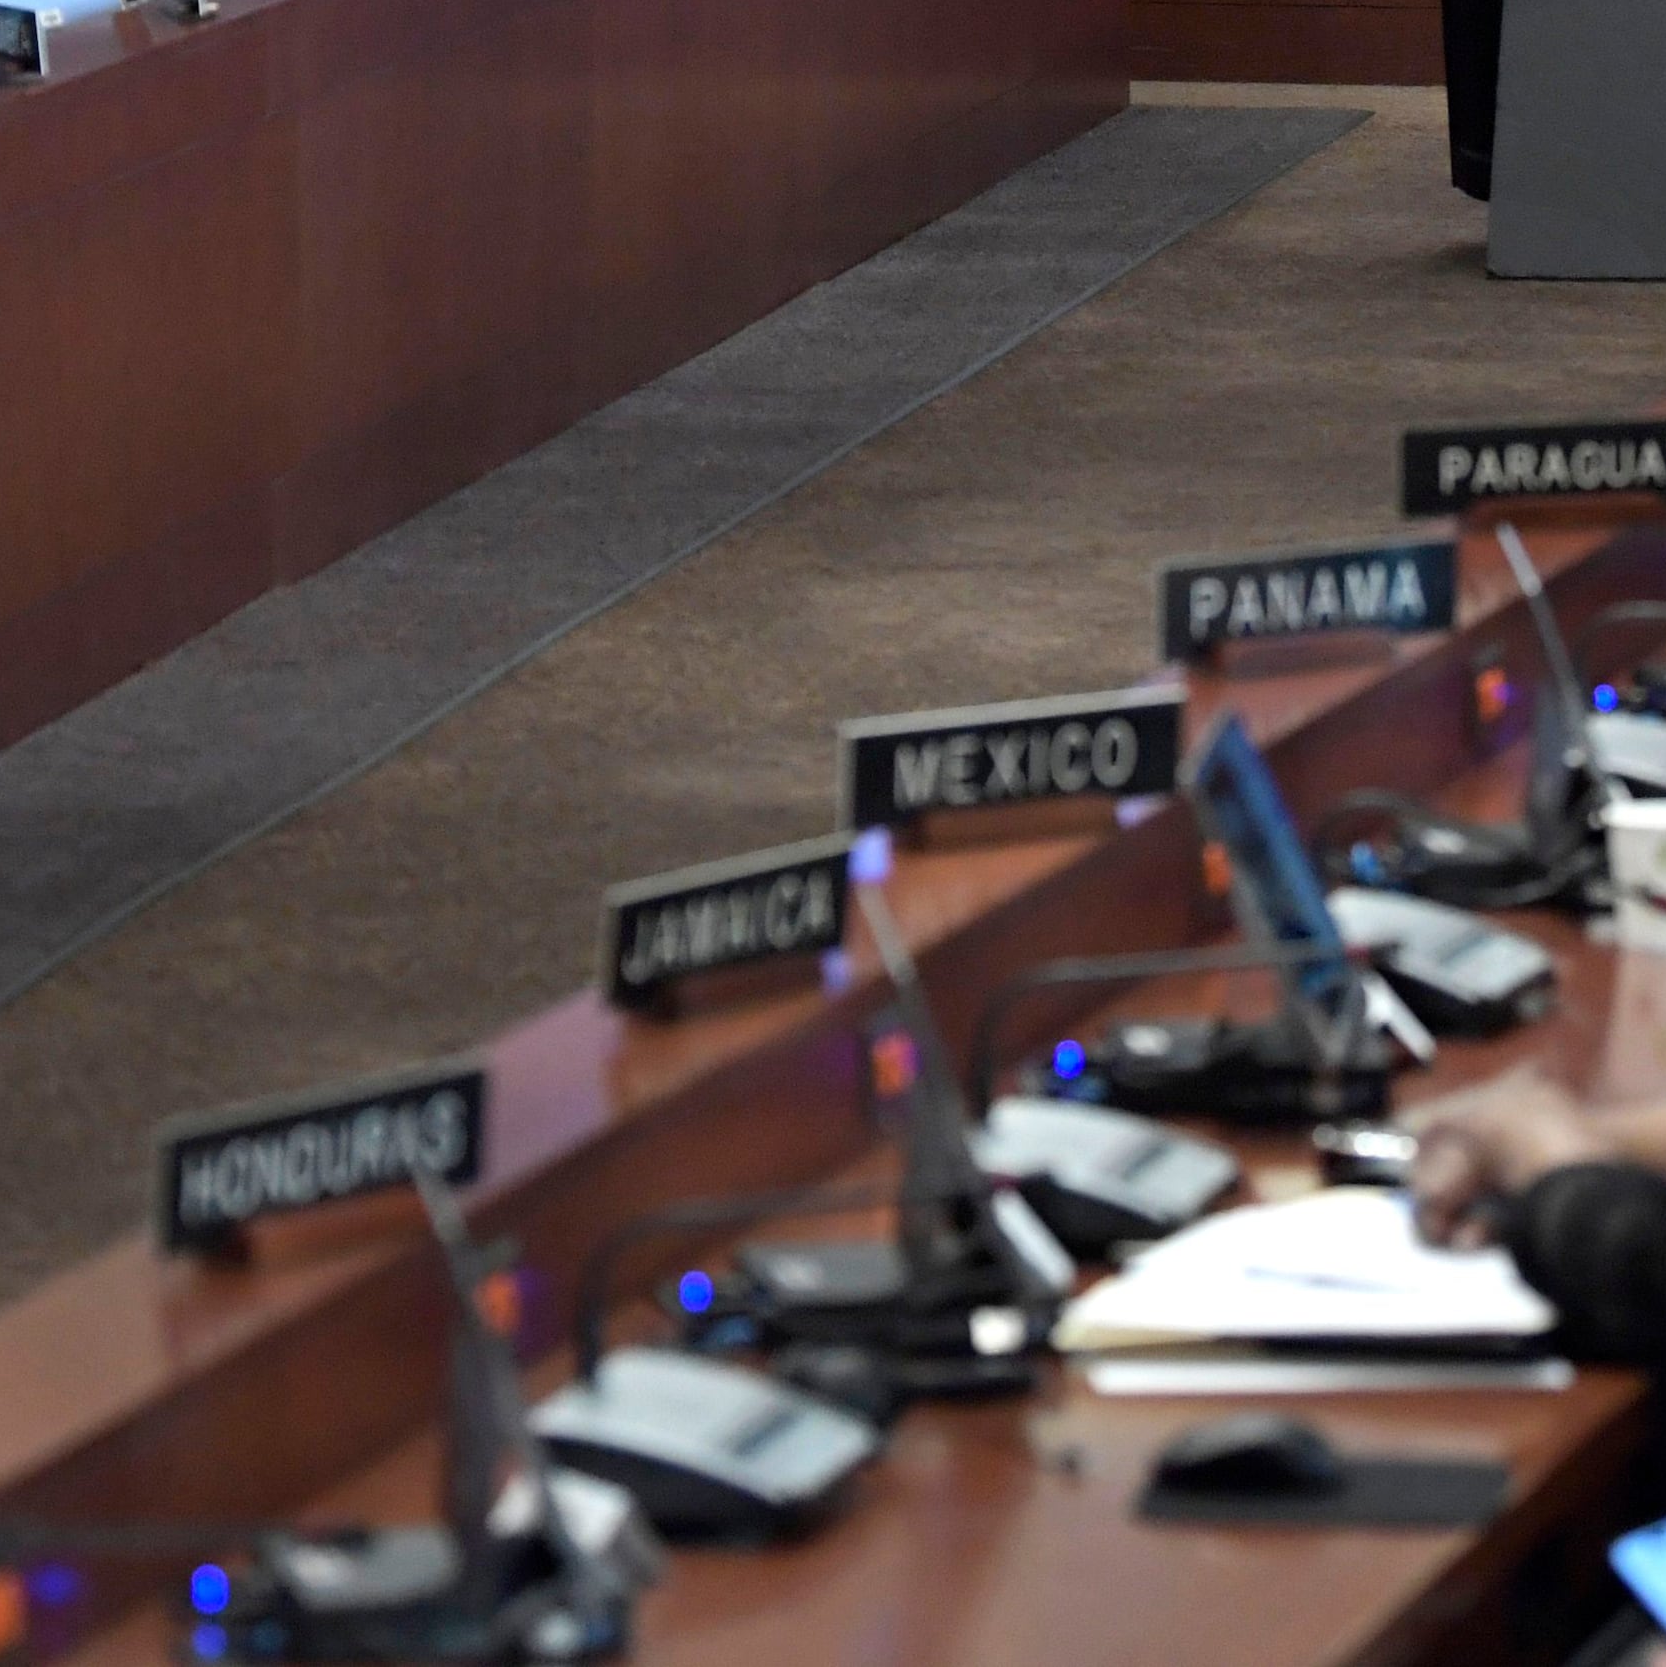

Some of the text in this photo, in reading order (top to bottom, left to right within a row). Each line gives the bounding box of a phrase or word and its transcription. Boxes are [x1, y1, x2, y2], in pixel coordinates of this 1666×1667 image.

[1188, 559, 1427, 637] PANAMA
[893, 717, 1138, 806] MEXICO
[620, 867, 835, 985] JAMAICA
